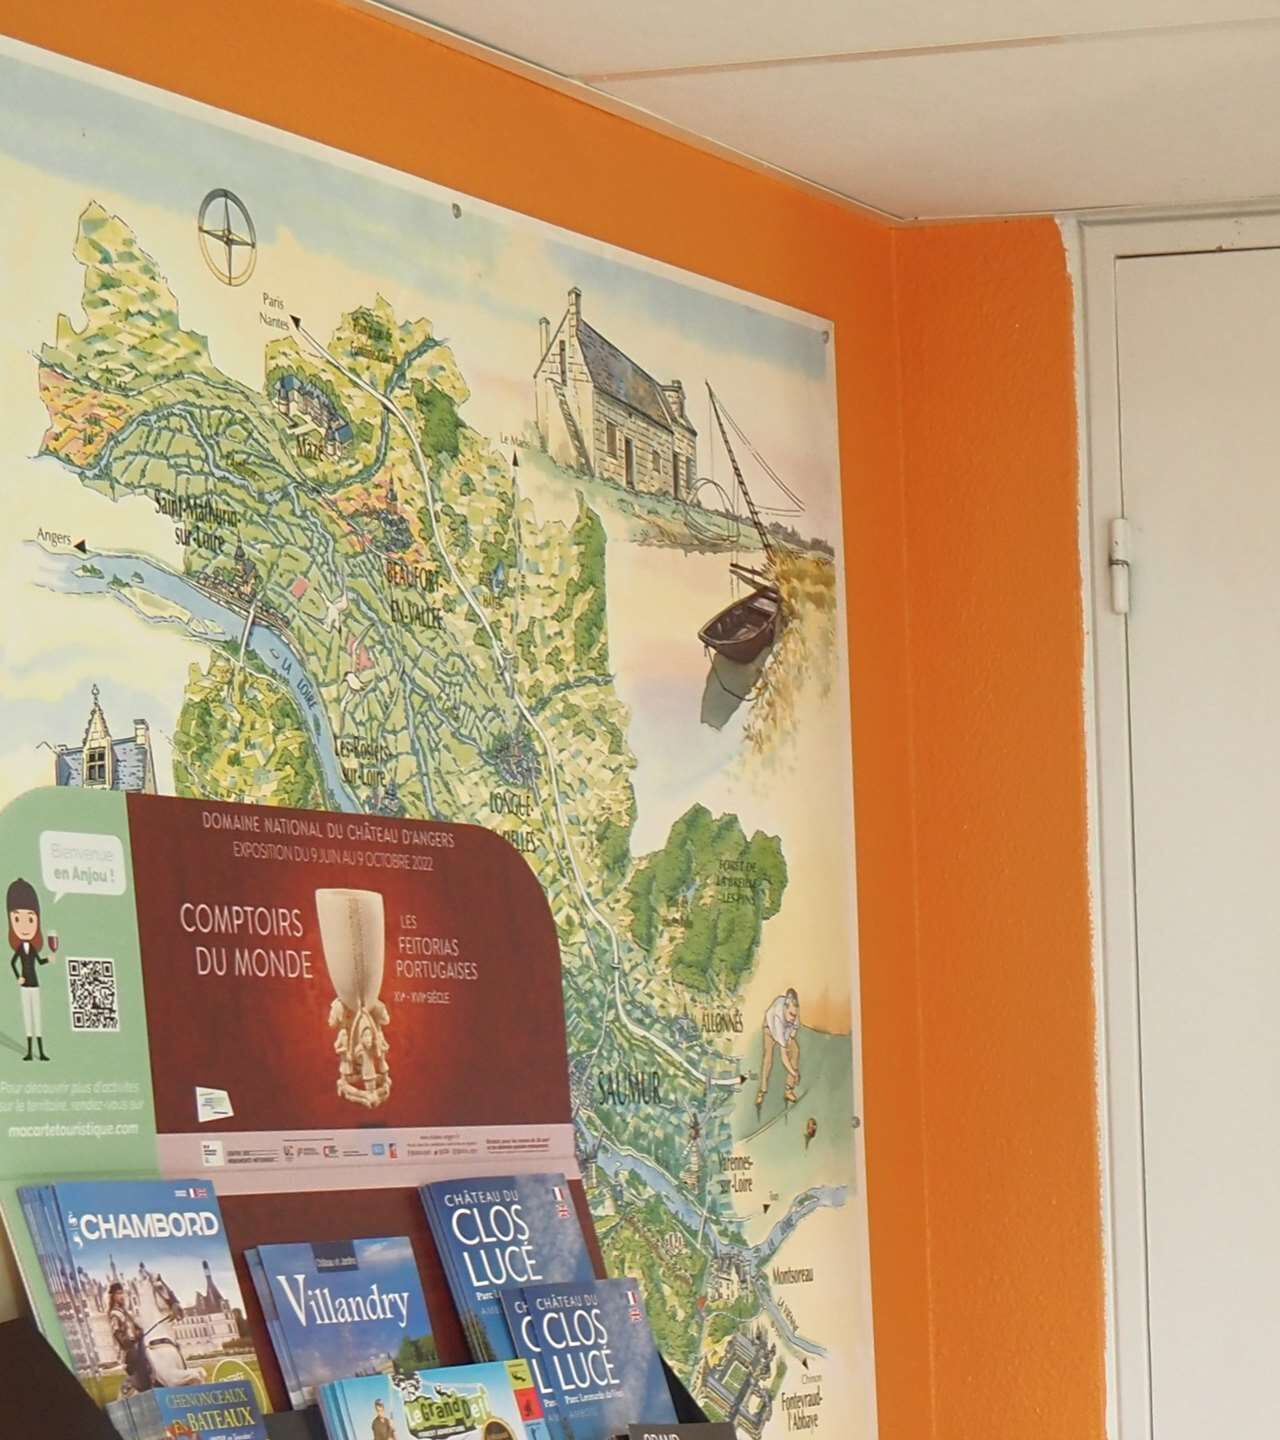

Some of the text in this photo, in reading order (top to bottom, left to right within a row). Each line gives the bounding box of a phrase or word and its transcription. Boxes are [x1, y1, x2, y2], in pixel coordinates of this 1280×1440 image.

[263, 292, 284, 310] Paris
[259, 312, 290, 331] Nantes
[37, 528, 72, 547] Angers
[296, 677, 319, 710] LOIRE
[202, 812, 455, 848] DOMAINE NATIONAL DU CHÂTEAU D'ANGERS
[50, 843, 115, 862] Bienvenue
[233, 841, 434, 871] EXPOSITION DU 9 JUIN AU 9 OCTOBRE 2022
[54, 865, 107, 885] en Anjou
[180, 903, 417, 938] COMPTOIRS LES
[195, 937, 459, 980] DU MONDE FEITORIAS
[396, 959, 478, 981] PORTUGAISES
[598, 1071, 661, 1106] SAUMUR
[444, 1190, 519, 1207] CHÂTEAU DU
[80, 1212, 219, 1239] CHAMBORD
[452, 1205, 529, 1245] CLOS
[463, 1241, 542, 1287] LUCÉ
[772, 1265, 814, 1284] Montsoreau
[276, 1275, 410, 1327] Villandry
[536, 1293, 598, 1310] CHÂTEAU DU
[542, 1309, 608, 1349] CLOS
[553, 1346, 619, 1390] LUCÉ
[166, 1388, 248, 1408] CHENONCEAUX
[188, 1408, 255, 1432] BATEAUX
